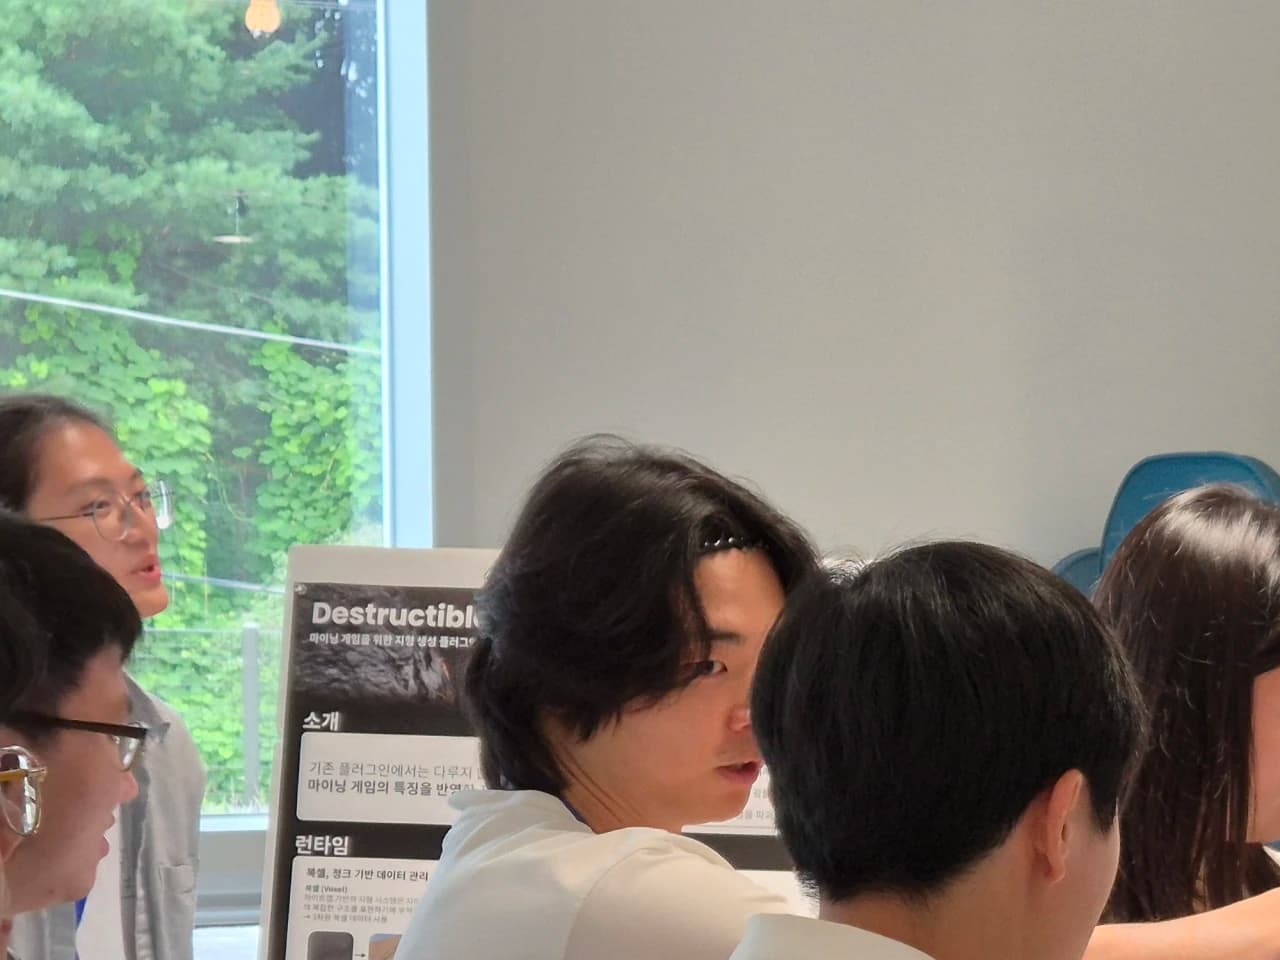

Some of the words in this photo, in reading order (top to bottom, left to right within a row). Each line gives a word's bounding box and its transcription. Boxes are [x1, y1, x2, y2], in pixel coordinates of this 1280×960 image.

[309, 631, 339, 646] 마이닝
[341, 633, 371, 647] 게임을
[373, 633, 393, 647] 위한
[417, 636, 437, 648] 생성
[302, 711, 340, 731] 소개
[309, 761, 336, 777] 기존
[339, 762, 429, 779] 플러그인에서는
[307, 778, 347, 794] 마이닝
[350, 780, 390, 794] 게임의
[393, 781, 432, 796] 특징을
[295, 834, 350, 856] 런타임
[354, 869, 374, 880] 기반
[376, 870, 406, 881] 데이터
[409, 871, 429, 881] 관리
